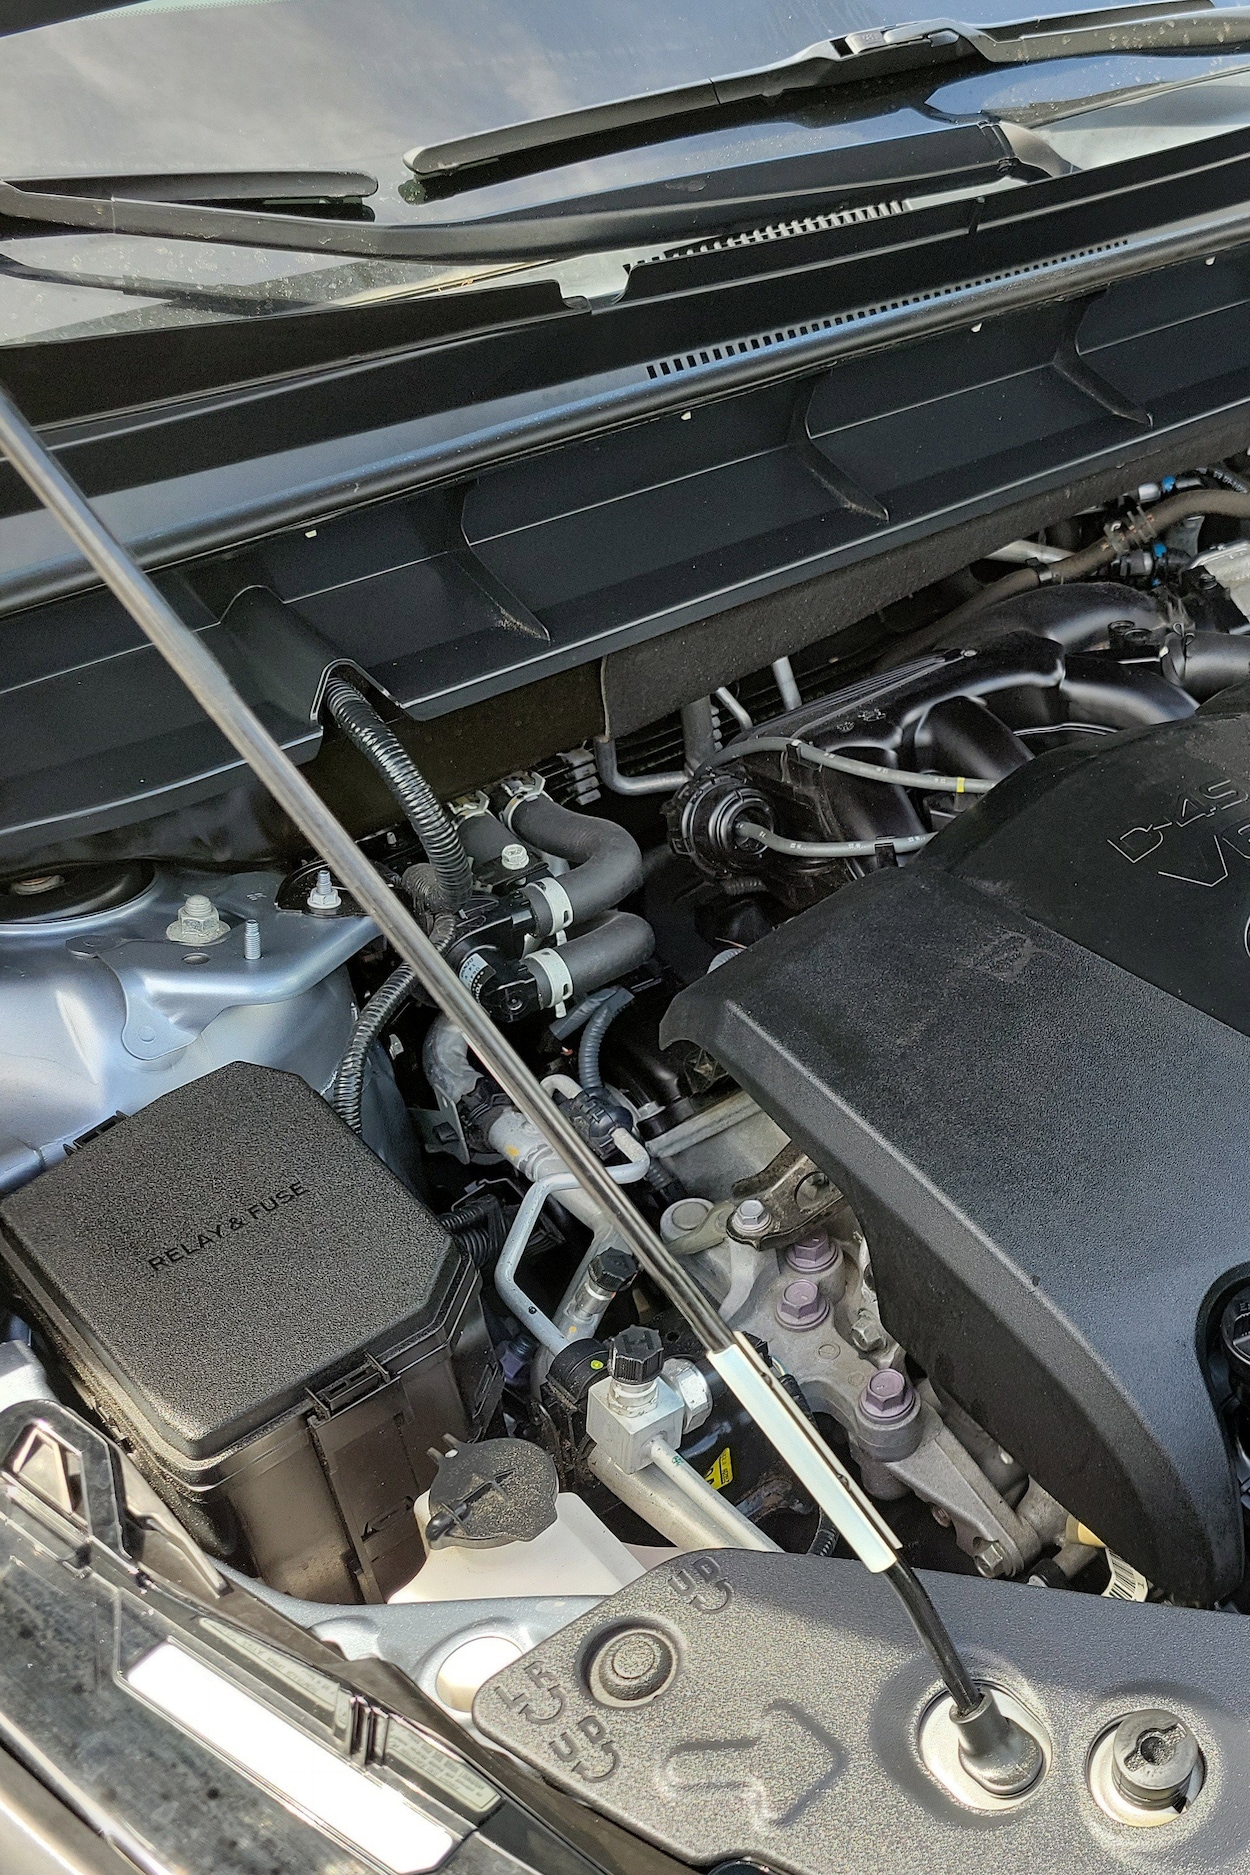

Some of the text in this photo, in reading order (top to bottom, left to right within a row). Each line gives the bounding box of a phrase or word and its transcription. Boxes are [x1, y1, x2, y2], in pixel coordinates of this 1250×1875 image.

[1107, 779, 1249, 863] D-4S
[148, 1181, 309, 1271] RELAY & FUSE
